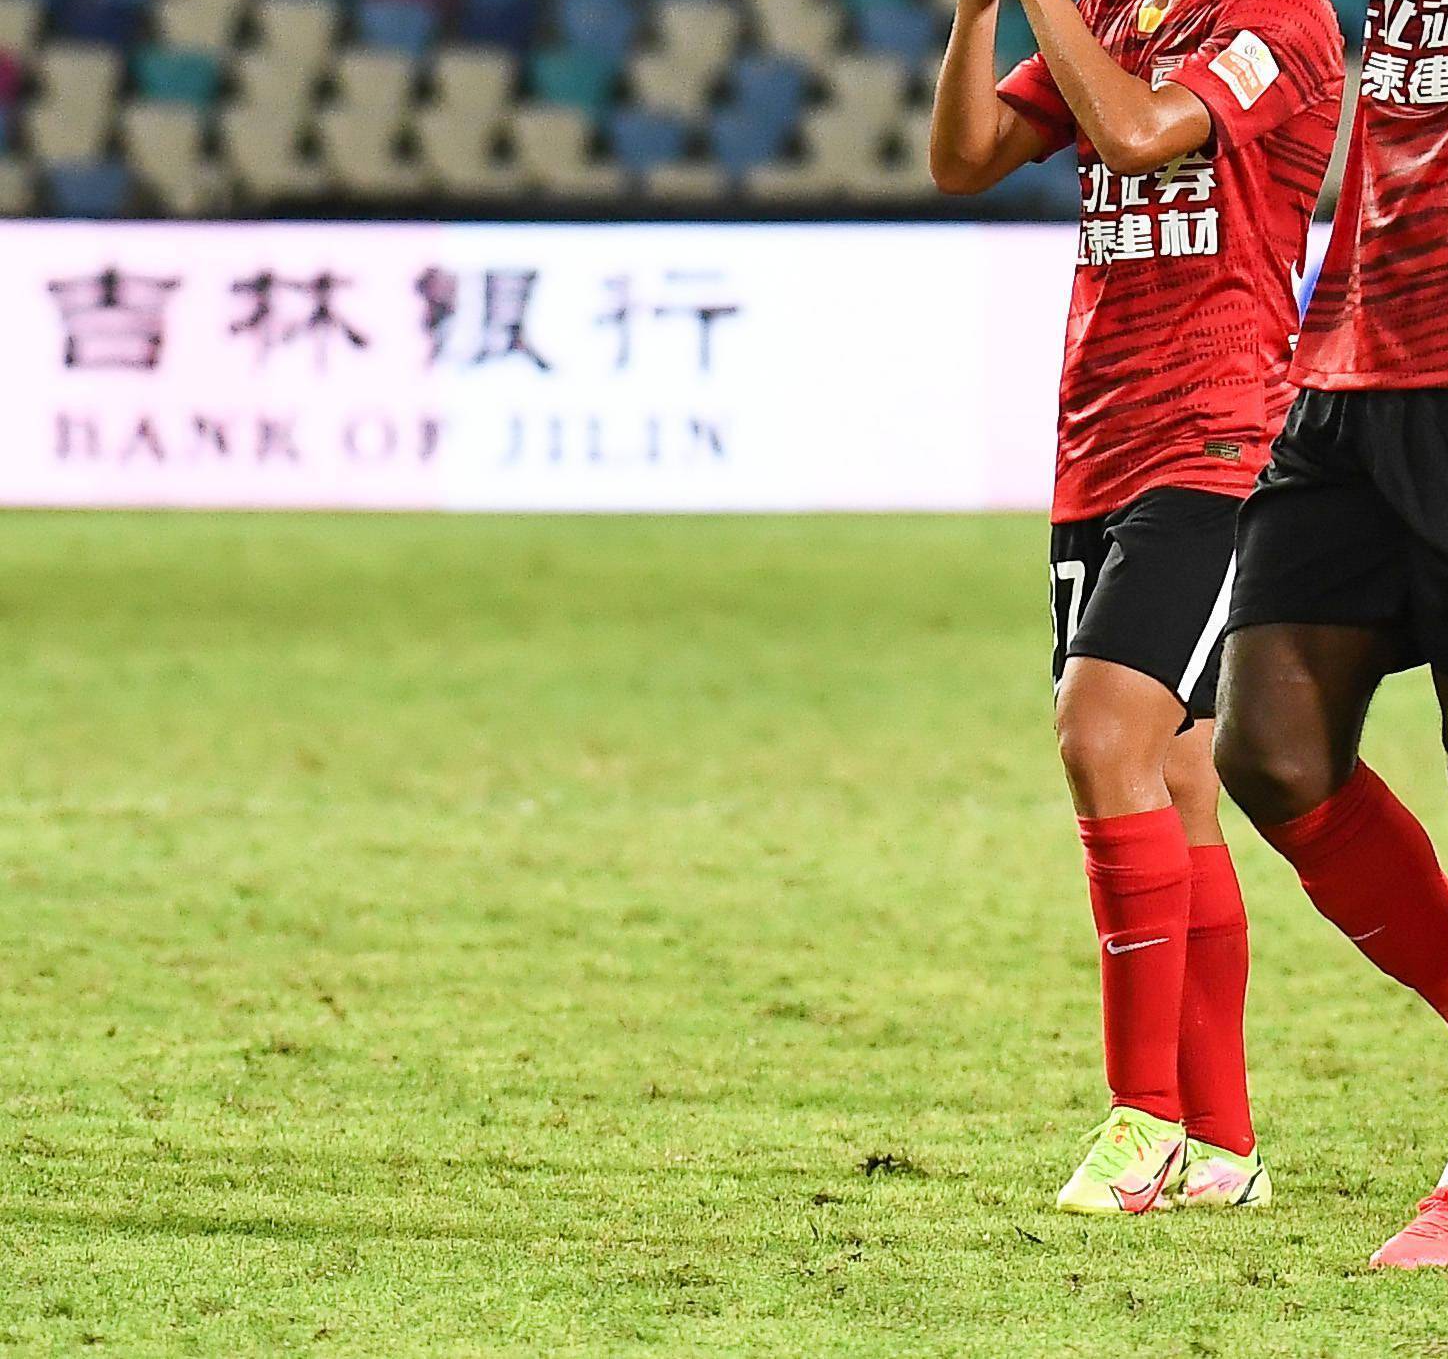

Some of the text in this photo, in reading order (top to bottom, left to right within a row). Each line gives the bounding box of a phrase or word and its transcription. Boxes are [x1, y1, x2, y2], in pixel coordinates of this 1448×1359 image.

[53, 408, 730, 466] BANK OF JILIN
